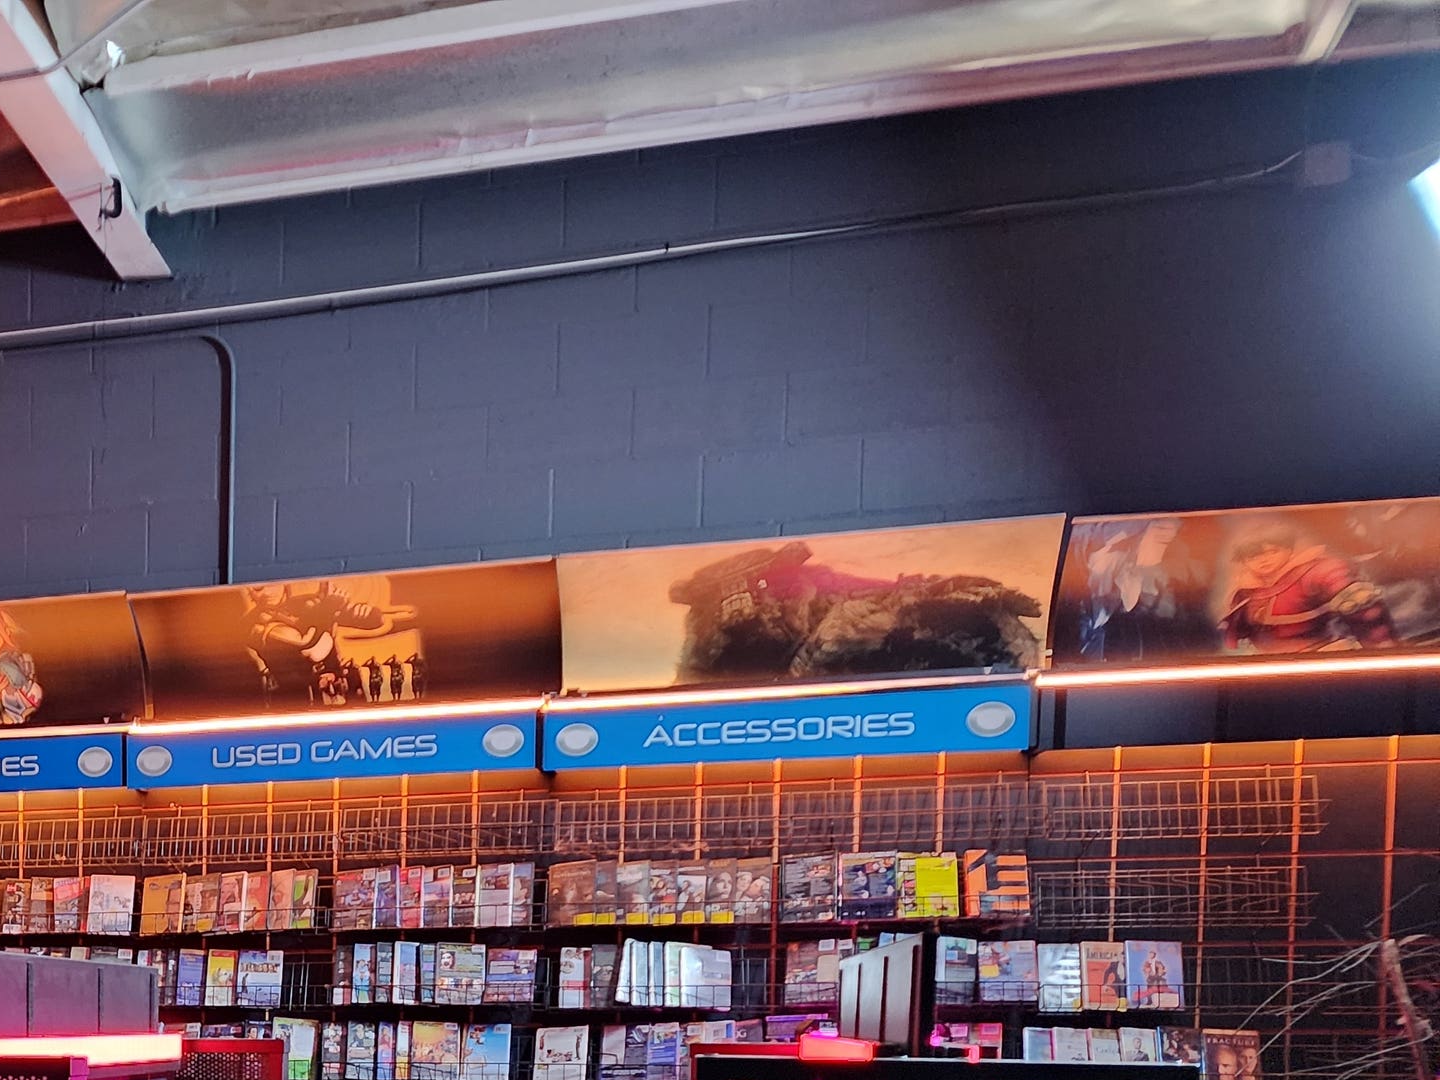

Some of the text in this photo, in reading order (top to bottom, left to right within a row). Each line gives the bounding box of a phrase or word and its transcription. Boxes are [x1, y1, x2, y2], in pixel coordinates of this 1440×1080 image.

[643, 712, 915, 748] ACCESSORIES
[212, 734, 437, 768] USED GAMES
